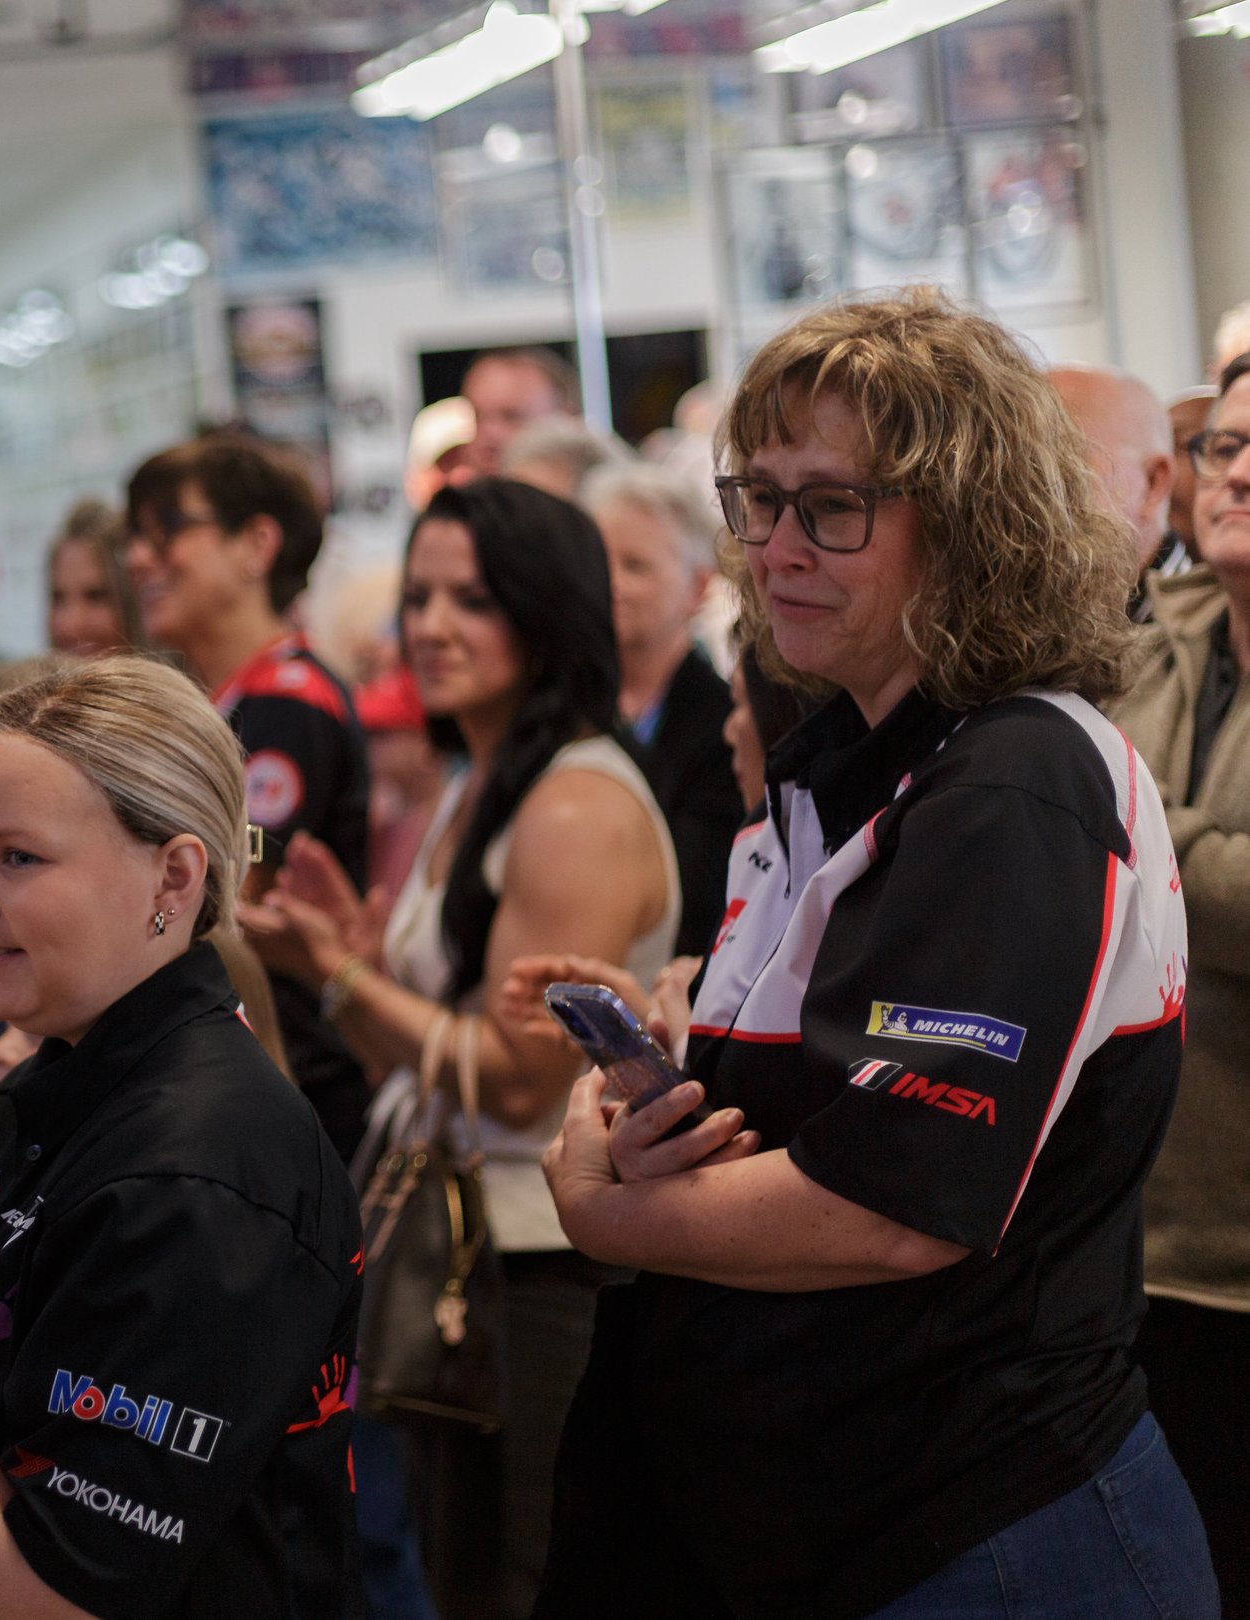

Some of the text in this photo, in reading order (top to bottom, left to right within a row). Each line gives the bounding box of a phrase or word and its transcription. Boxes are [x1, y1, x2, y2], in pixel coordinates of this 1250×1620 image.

[913, 1019, 1010, 1047] MICHELIN
[888, 1072, 996, 1126] IMSA
[48, 1368, 174, 1446] Mobil
[47, 1466, 184, 1544] YOKOHAMA
